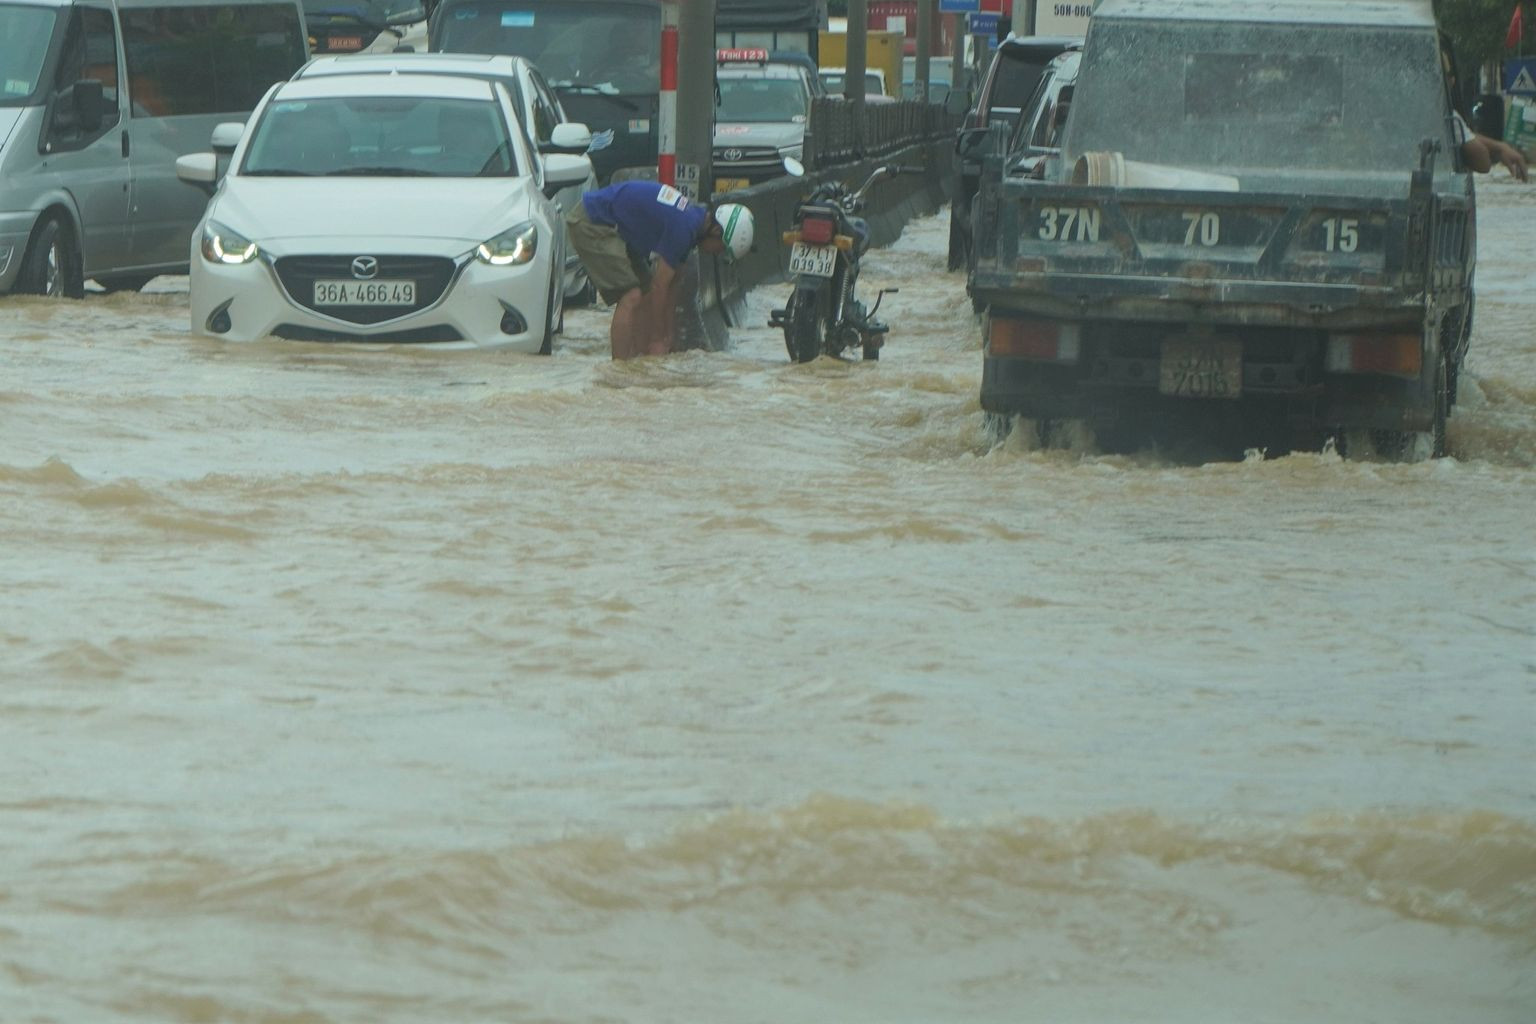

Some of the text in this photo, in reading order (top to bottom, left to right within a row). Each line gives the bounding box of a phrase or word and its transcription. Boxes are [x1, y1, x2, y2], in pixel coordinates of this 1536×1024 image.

[720, 49, 765, 61] Taxi 123
[1039, 207, 1360, 253] 37N 70 15
[316, 283, 414, 303] 36A-466.49
